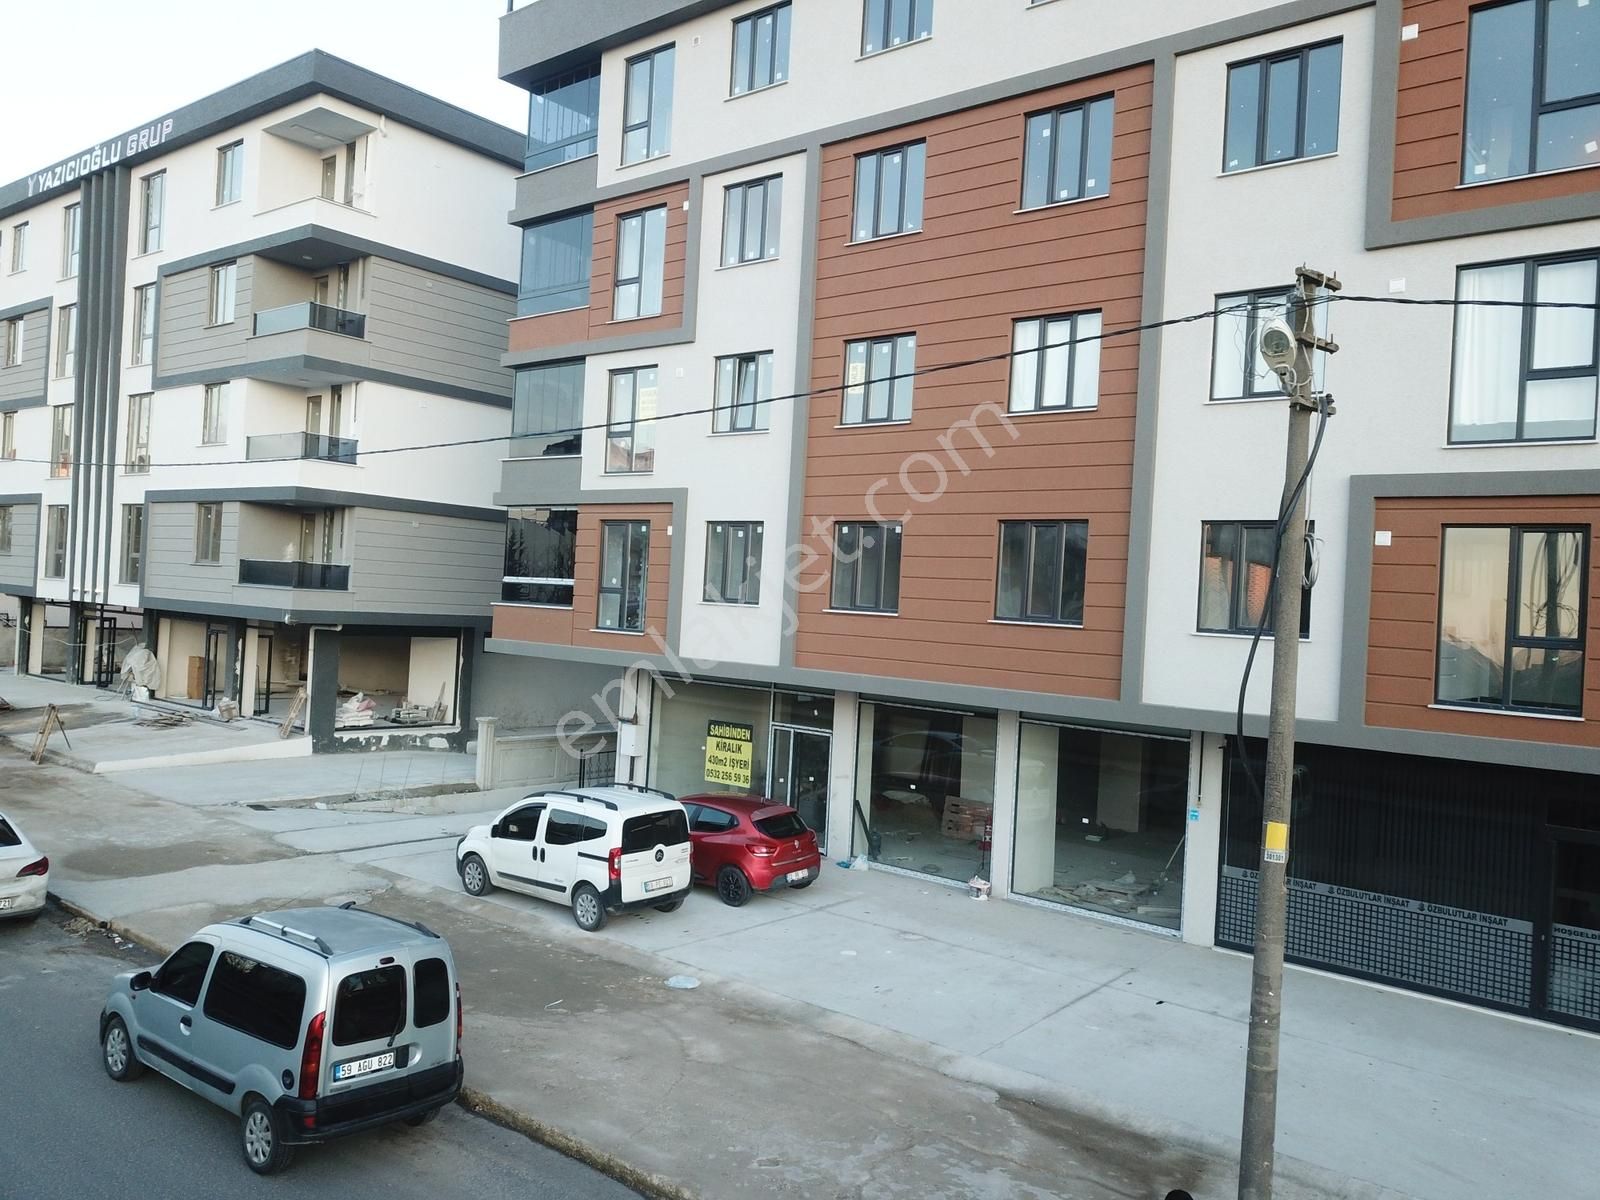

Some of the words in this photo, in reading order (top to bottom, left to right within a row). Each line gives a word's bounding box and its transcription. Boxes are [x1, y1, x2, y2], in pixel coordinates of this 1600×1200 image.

[38, 141, 121, 192] YAZICIOĞLU
[126, 119, 173, 157] GRUP
[710, 724, 751, 740] SAHİBİNDEN
[341, 1064, 352, 1077] 59
[357, 1058, 373, 1072] AGU
[378, 1054, 393, 1067] 822
